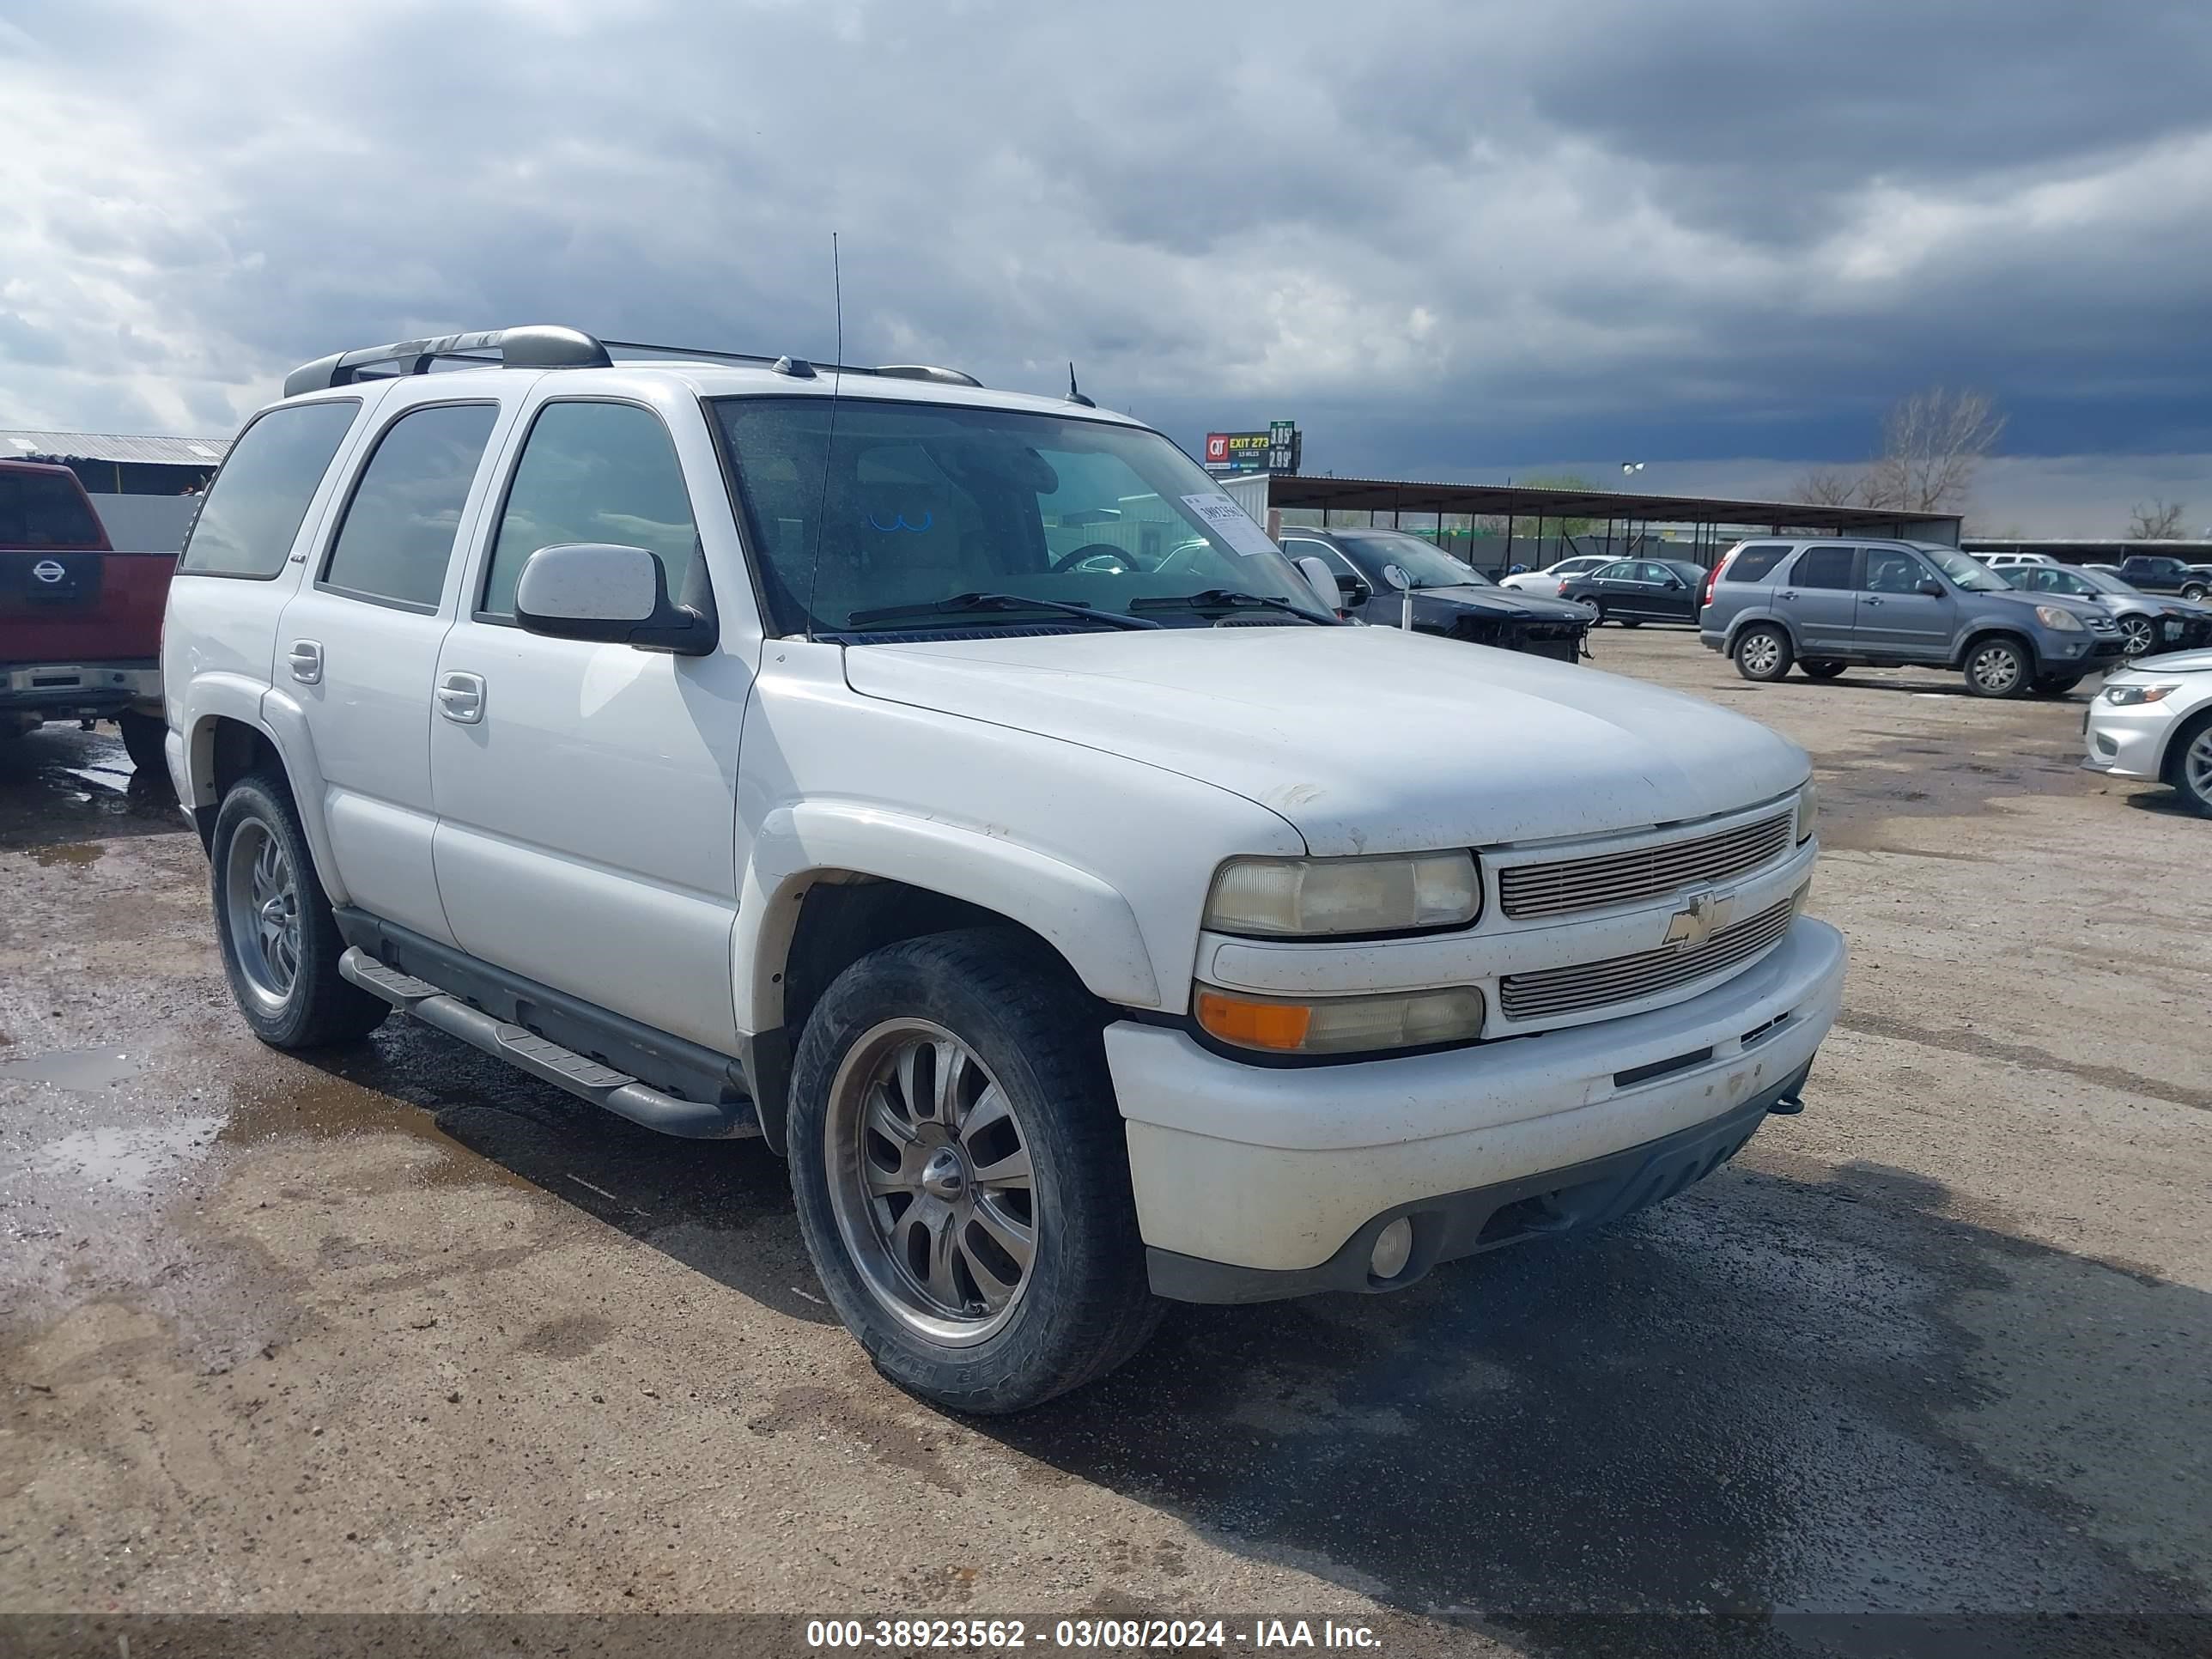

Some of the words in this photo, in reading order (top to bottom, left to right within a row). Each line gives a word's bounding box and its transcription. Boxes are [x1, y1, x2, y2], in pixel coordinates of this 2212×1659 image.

[1210, 440, 1225, 457] QT
[1230, 438, 1250, 448] EXIT
[1251, 437, 1269, 447] 273
